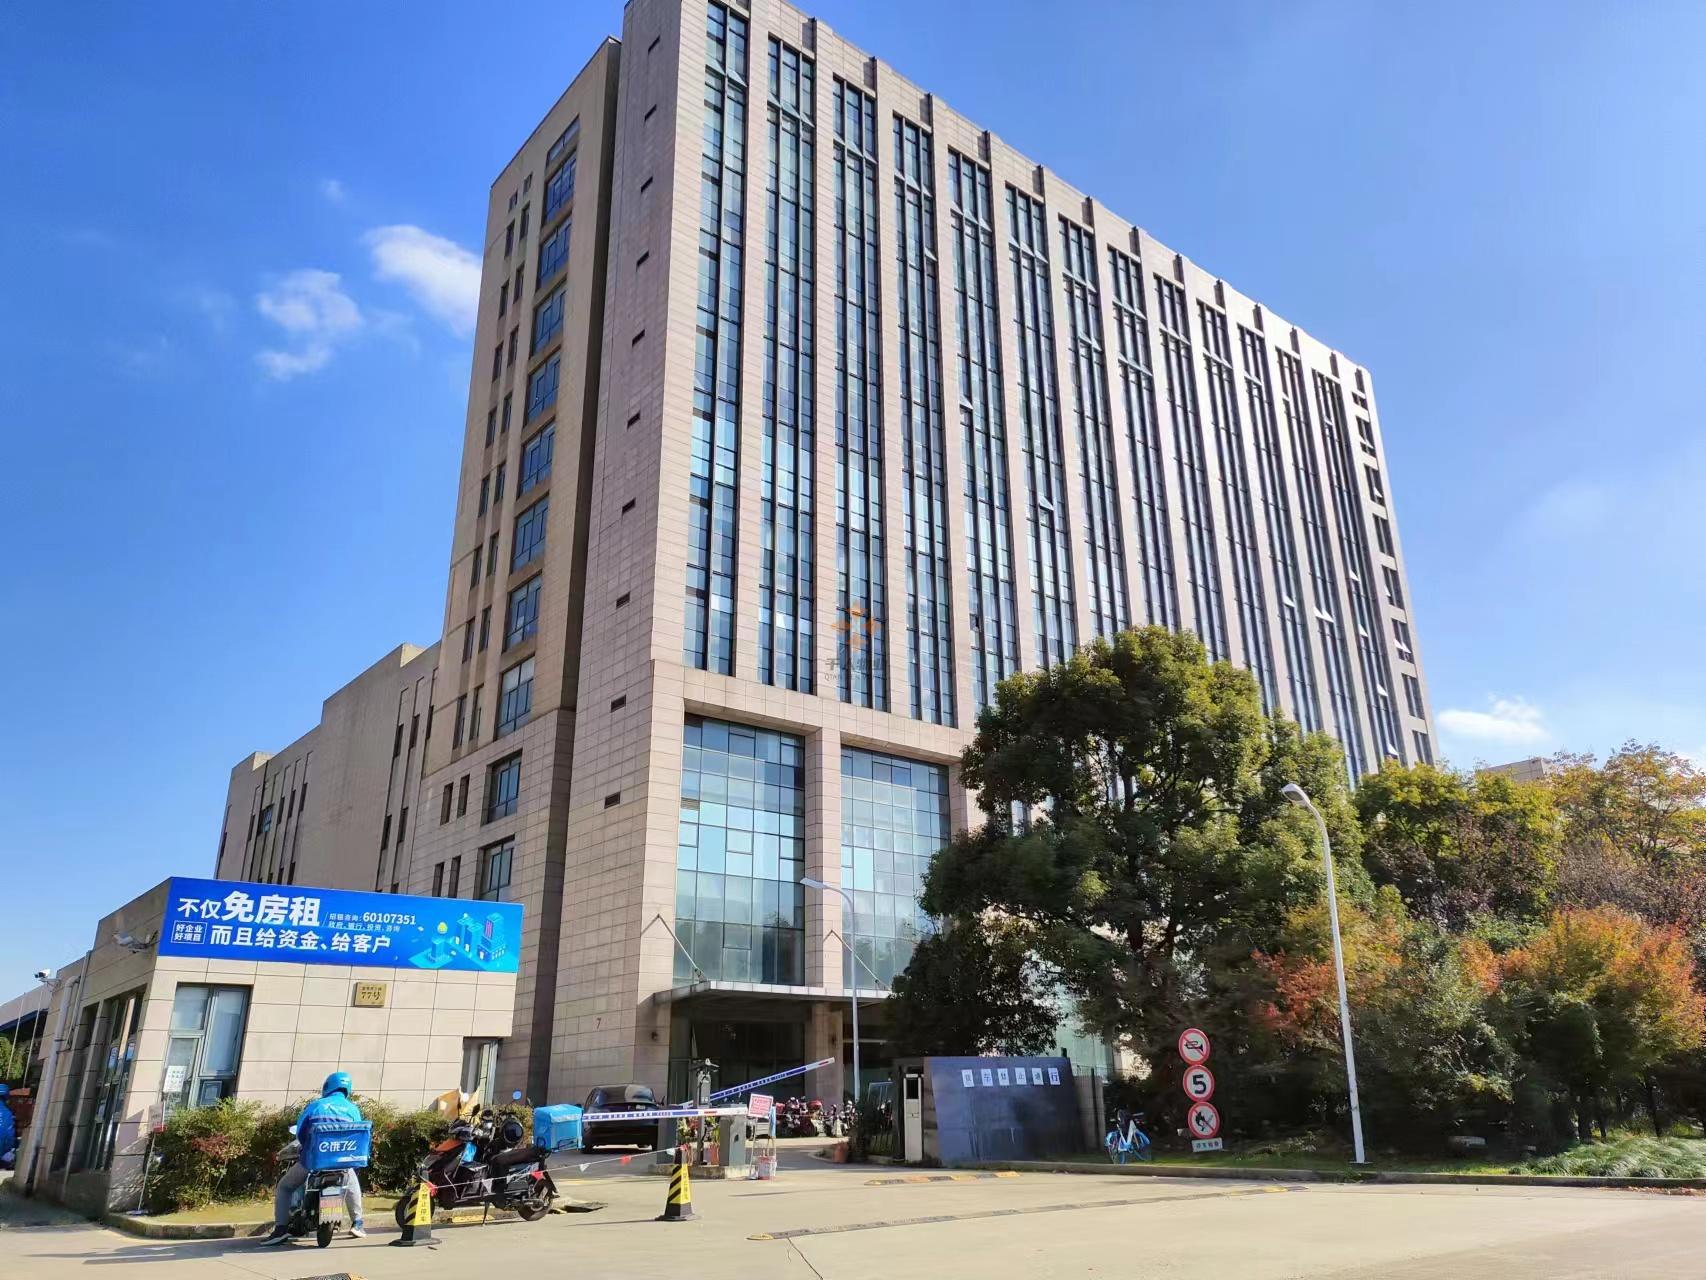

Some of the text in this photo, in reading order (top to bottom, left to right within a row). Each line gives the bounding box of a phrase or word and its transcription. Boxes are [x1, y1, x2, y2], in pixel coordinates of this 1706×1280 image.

[177, 890, 321, 927] 不仅免房租
[174, 932, 201, 942] 好项目
[175, 924, 203, 933] 好企业
[210, 925, 391, 953] 而且给资金、给客户
[1192, 1074, 1207, 1094] 5
